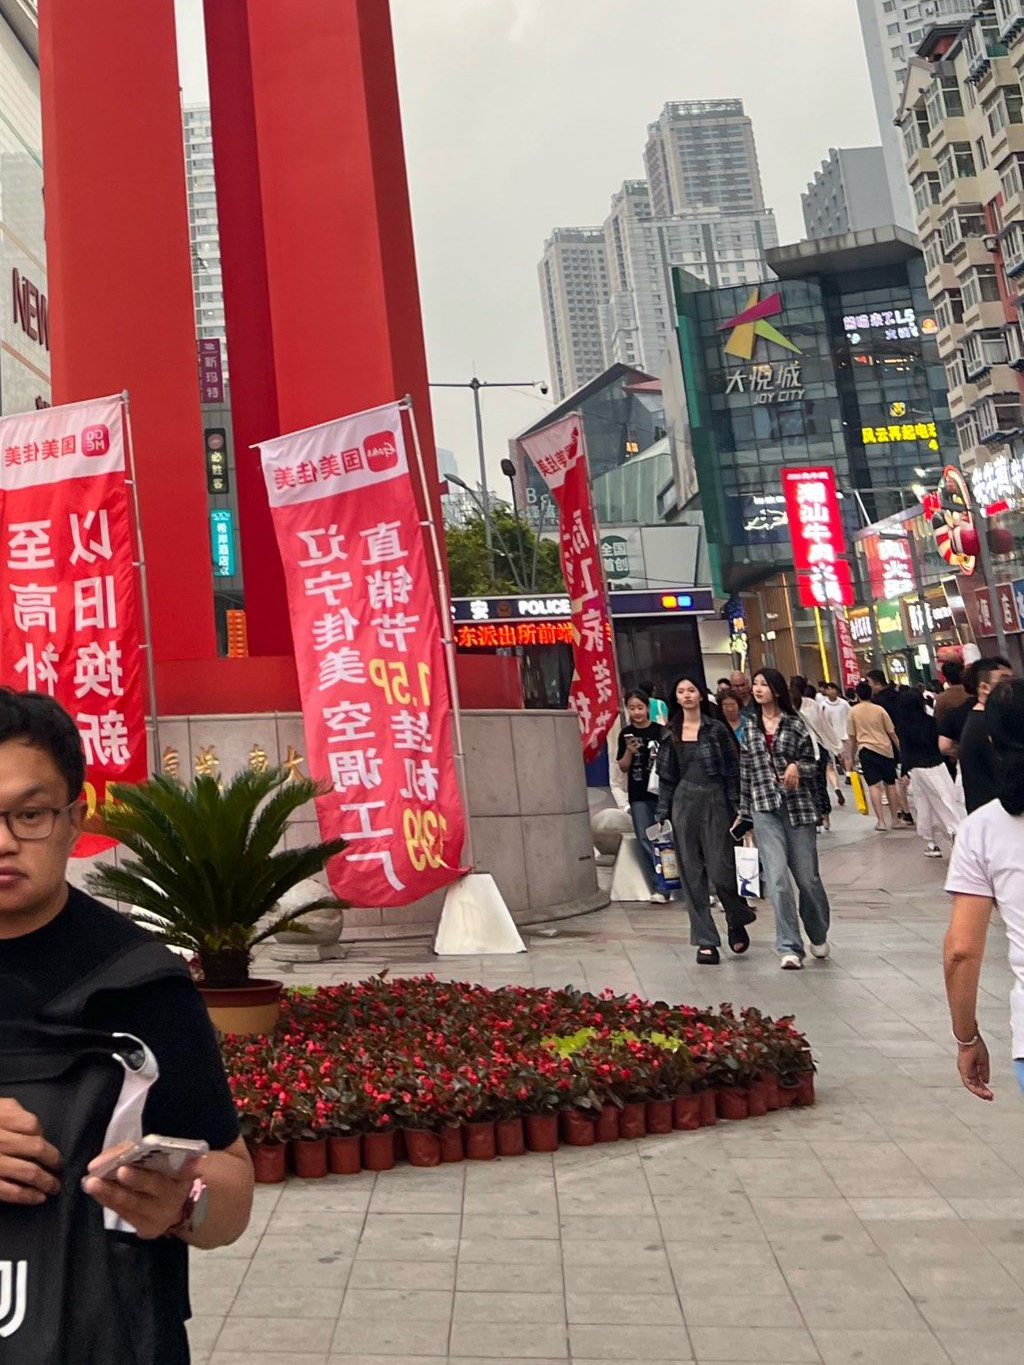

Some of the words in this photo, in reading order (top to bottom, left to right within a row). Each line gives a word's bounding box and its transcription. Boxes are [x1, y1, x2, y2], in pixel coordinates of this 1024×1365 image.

[204, 356, 221, 399] 新玛特
[725, 364, 802, 394] 大悦城
[753, 392, 775, 405] JOY
[778, 389, 805, 402] CITY
[210, 451, 223, 489] 必胜客
[601, 542, 627, 556] 全国
[603, 557, 628, 572] 首创
[518, 599, 571, 616] POLICE
